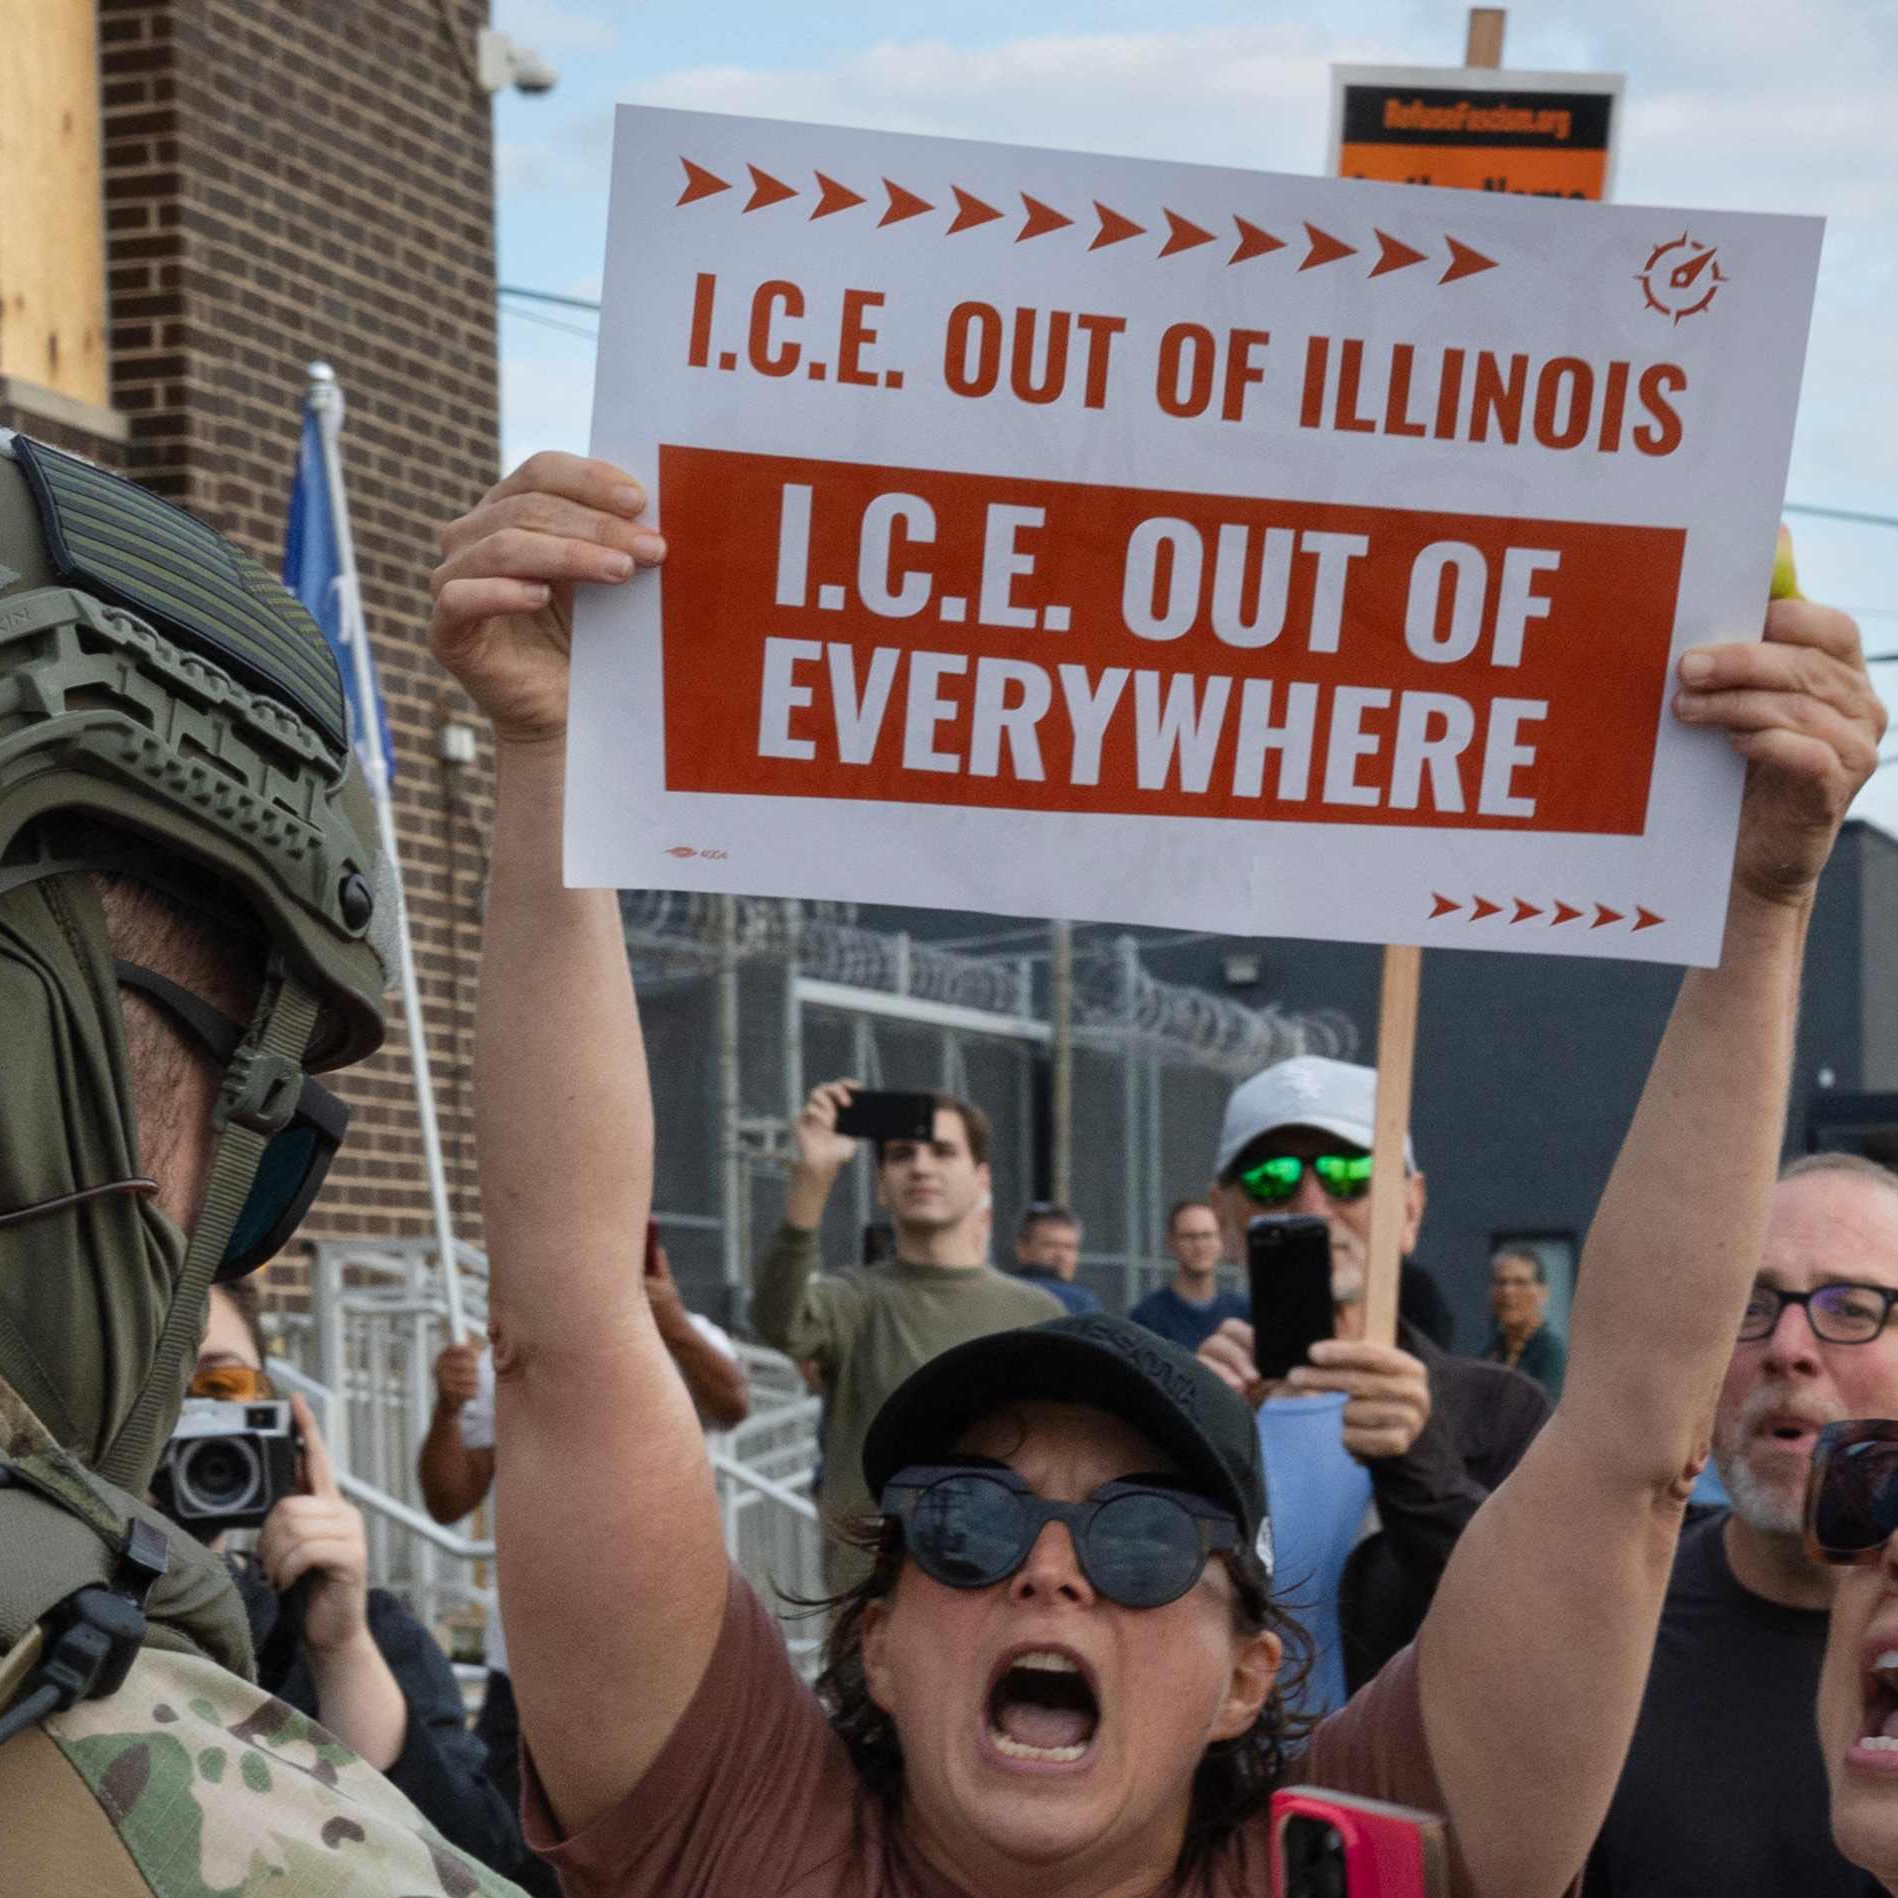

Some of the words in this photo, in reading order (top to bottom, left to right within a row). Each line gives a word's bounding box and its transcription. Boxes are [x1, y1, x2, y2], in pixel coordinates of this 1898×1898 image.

[687, 271, 905, 391] I.C.E.
[942, 299, 1127, 412] OUT
[1153, 320, 1272, 424] OF
[1297, 335, 1689, 459] ILLINOIS
[773, 481, 1073, 634] I.C.E.
[1119, 515, 1371, 656] OUT
[1402, 538, 1563, 670] OF
[756, 634, 1551, 820] EVERYWHERE
